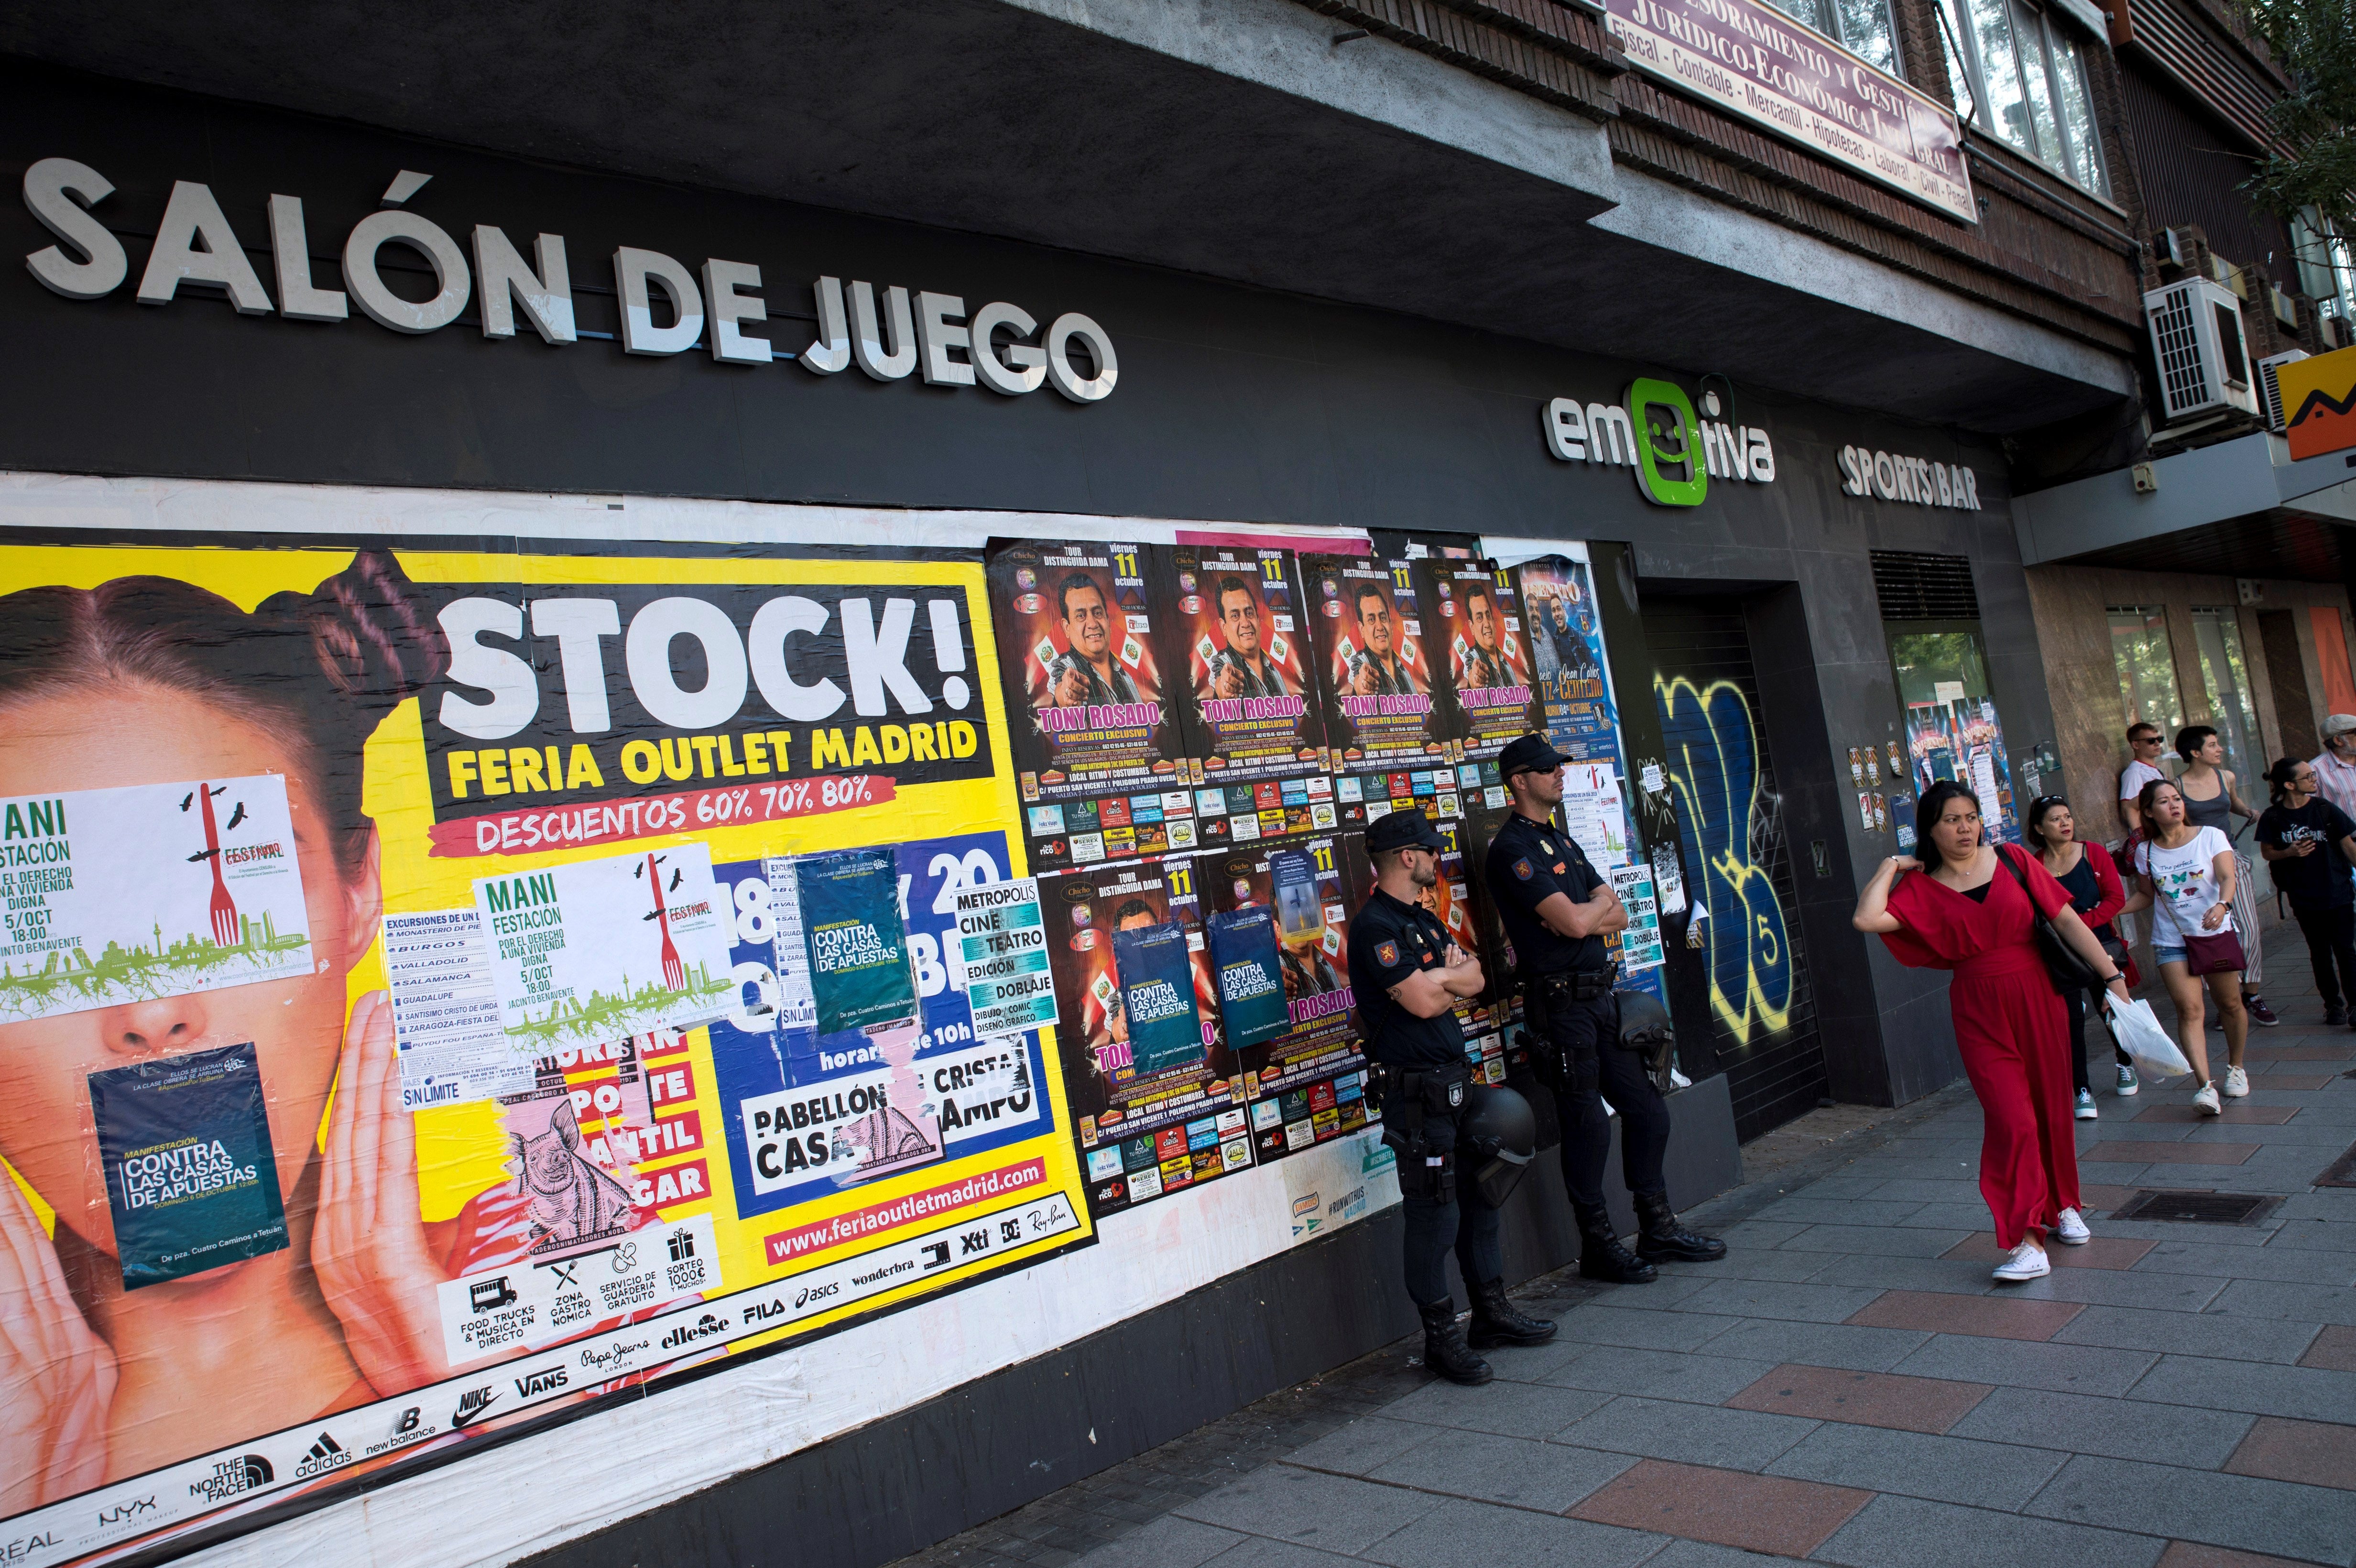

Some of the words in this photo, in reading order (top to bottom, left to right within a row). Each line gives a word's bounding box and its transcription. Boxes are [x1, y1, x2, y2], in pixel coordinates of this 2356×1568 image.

[1834, 63, 1847, 88] Y
[1853, 66, 1927, 133] GESTIÓN
[1673, 48, 1734, 98] Contable
[1745, 83, 1802, 131] Mercantil
[1812, 116, 1865, 160] Hipotecas
[1873, 147, 1909, 182] Laboral
[1920, 171, 1940, 196] Civil
[1946, 184, 1970, 211] Penal
[1870, 107, 1951, 175] INTEGRAL
[23, 157, 577, 346] SALÓN
[612, 246, 773, 365] DE
[798, 275, 1118, 404] JUEGO
[1837, 444, 1933, 506] SPORTS
[1933, 462, 1981, 510] BAR
[1064, 546, 1082, 557] TOUR
[1110, 543, 1137, 554] viernes
[1044, 556, 1089, 567] DISTINGUIDA
[1090, 558, 1109, 567] DAMA
[1114, 554, 1137, 577] 11
[1115, 577, 1143, 587] octubre
[436, 596, 971, 739] STOCK!
[1581, 663, 1600, 683] Carlos
[1038, 707, 1085, 733] TONY
[1089, 702, 1159, 730] ROSADO
[1201, 699, 1242, 722] TONY
[1243, 695, 1304, 719] ROSADO
[1058, 731, 1104, 743] CONCIERTO
[1106, 729, 1147, 740] EXCLUSIVO
[447, 744, 604, 798] FERIA
[623, 731, 791, 784] OUTLET
[811, 719, 977, 769] MADRID
[477, 798, 687, 852] DESCUENTOS
[697, 790, 752, 822] 60%
[761, 781, 813, 821] 70%
[821, 774, 872, 807] 80%
[2173, 859, 2193, 871] perfect
[1614, 870, 1649, 884] METROPOLIS
[485, 873, 558, 914] MANI
[716, 878, 774, 947] 18
[928, 849, 1000, 914] 20
[958, 885, 1036, 910] METROPOLIS
[1628, 900, 1654, 914] TEATRO
[387, 915, 447, 929] EXCURSIONES
[492, 904, 562, 935] FESTACIÓN
[960, 914, 1000, 935] CINE
[398, 940, 466, 952] BURGOS
[498, 939, 516, 951] POR
[517, 936, 526, 947] EL
[528, 928, 564, 946] DERECHO
[502, 951, 507, 960] A
[509, 947, 526, 958] UNA
[526, 939, 566, 956] VIVIENDA
[987, 930, 1043, 953] TEATRO
[401, 957, 469, 969] VALLADOLID
[522, 954, 548, 968] DIGNA
[968, 960, 1015, 979] EDICIÓN
[403, 973, 471, 986] SALAMANCA
[522, 965, 553, 983] 5/OCT
[403, 992, 454, 1004] GUADALUPE
[508, 994, 536, 1010] JACINTO
[536, 987, 575, 1004] BENAVENTE
[526, 981, 551, 995] 18:00
[996, 977, 1051, 1000] DOBLAJE
[975, 1007, 1000, 1021] DIBUJO
[1009, 1002, 1032, 1015] COMIC
[976, 1019, 1004, 1033] DISEÑO
[1005, 1013, 1036, 1027] GRÁFICO
[934, 1022, 971, 1047] 10h
[164, 1076, 188, 1085] OBRERA
[197, 1067, 224, 1078] ARRUINA
[199, 1063, 223, 1073] LUCRAN
[158, 1073, 225, 1091] #ApuestaPorTuBarrio
[425, 1082, 459, 1101] LIMITE
[753, 1083, 887, 1138] PABELLÓN
[124, 1136, 198, 1159] MANIFESTACIÓN
[126, 1140, 227, 1178] CONTRA
[128, 1172, 165, 1194] LAS
[171, 1155, 234, 1180] CASAS
[131, 1189, 158, 1209] DE
[161, 1165, 257, 1200] APUESTAS
[154, 1196, 189, 1210] DOMINGO
[207, 1183, 238, 1197] OCTUBRE
[239, 1179, 260, 1188] 12:00h
[773, 1164, 1039, 1258] www.feriaoutletmadrid.com
[1295, 1197, 1318, 1212] BIMBO
[1328, 1186, 1364, 1216] #RUNWITHUS
[1344, 1198, 1365, 1219] MADRID
[162, 1255, 173, 1263] De
[175, 1251, 191, 1261] pza.
[192, 1243, 218, 1255] Cuatro
[219, 1234, 252, 1247] Caminos
[258, 1225, 283, 1238] Tetuán
[667, 1259, 703, 1275] SORTEO
[669, 1268, 706, 1286] 1000€
[600, 1276, 642, 1294] SERVICIO
[646, 1272, 657, 1282] DE
[551, 1299, 591, 1318] GASTRO
[556, 1292, 584, 1307] ZONA
[608, 1292, 655, 1310] GRATUITO
[461, 1317, 490, 1334] FOOD
[492, 1305, 535, 1326] TRUCKS
[477, 1321, 518, 1339] MUSICA
[521, 1316, 534, 1326] EN
[552, 1310, 592, 1327] NOMICA
[479, 1329, 524, 1349] DIRECTO
[604, 1360, 633, 1373] LONDON
[98, 1494, 156, 1525] NYX
[212, 1457, 243, 1475] THE
[295, 1448, 352, 1478] adidas
[459, 1386, 493, 1412] NIKE
[514, 1365, 568, 1399] VANS
[580, 1348, 613, 1369] Pepe
[613, 1339, 651, 1361] Jeans
[662, 1317, 730, 1350] ellesse
[743, 1299, 785, 1326] FILA
[809, 1283, 840, 1301] asics
[851, 1259, 915, 1287] wonderbra
[366, 1440, 389, 1456] new
[390, 1425, 436, 1448] balance
[189, 1466, 246, 1497] NORTH
[206, 1481, 248, 1503] FACE
[78, 1520, 143, 1546] PROFESSIONAL
[147, 1508, 180, 1522] MAKEUP
